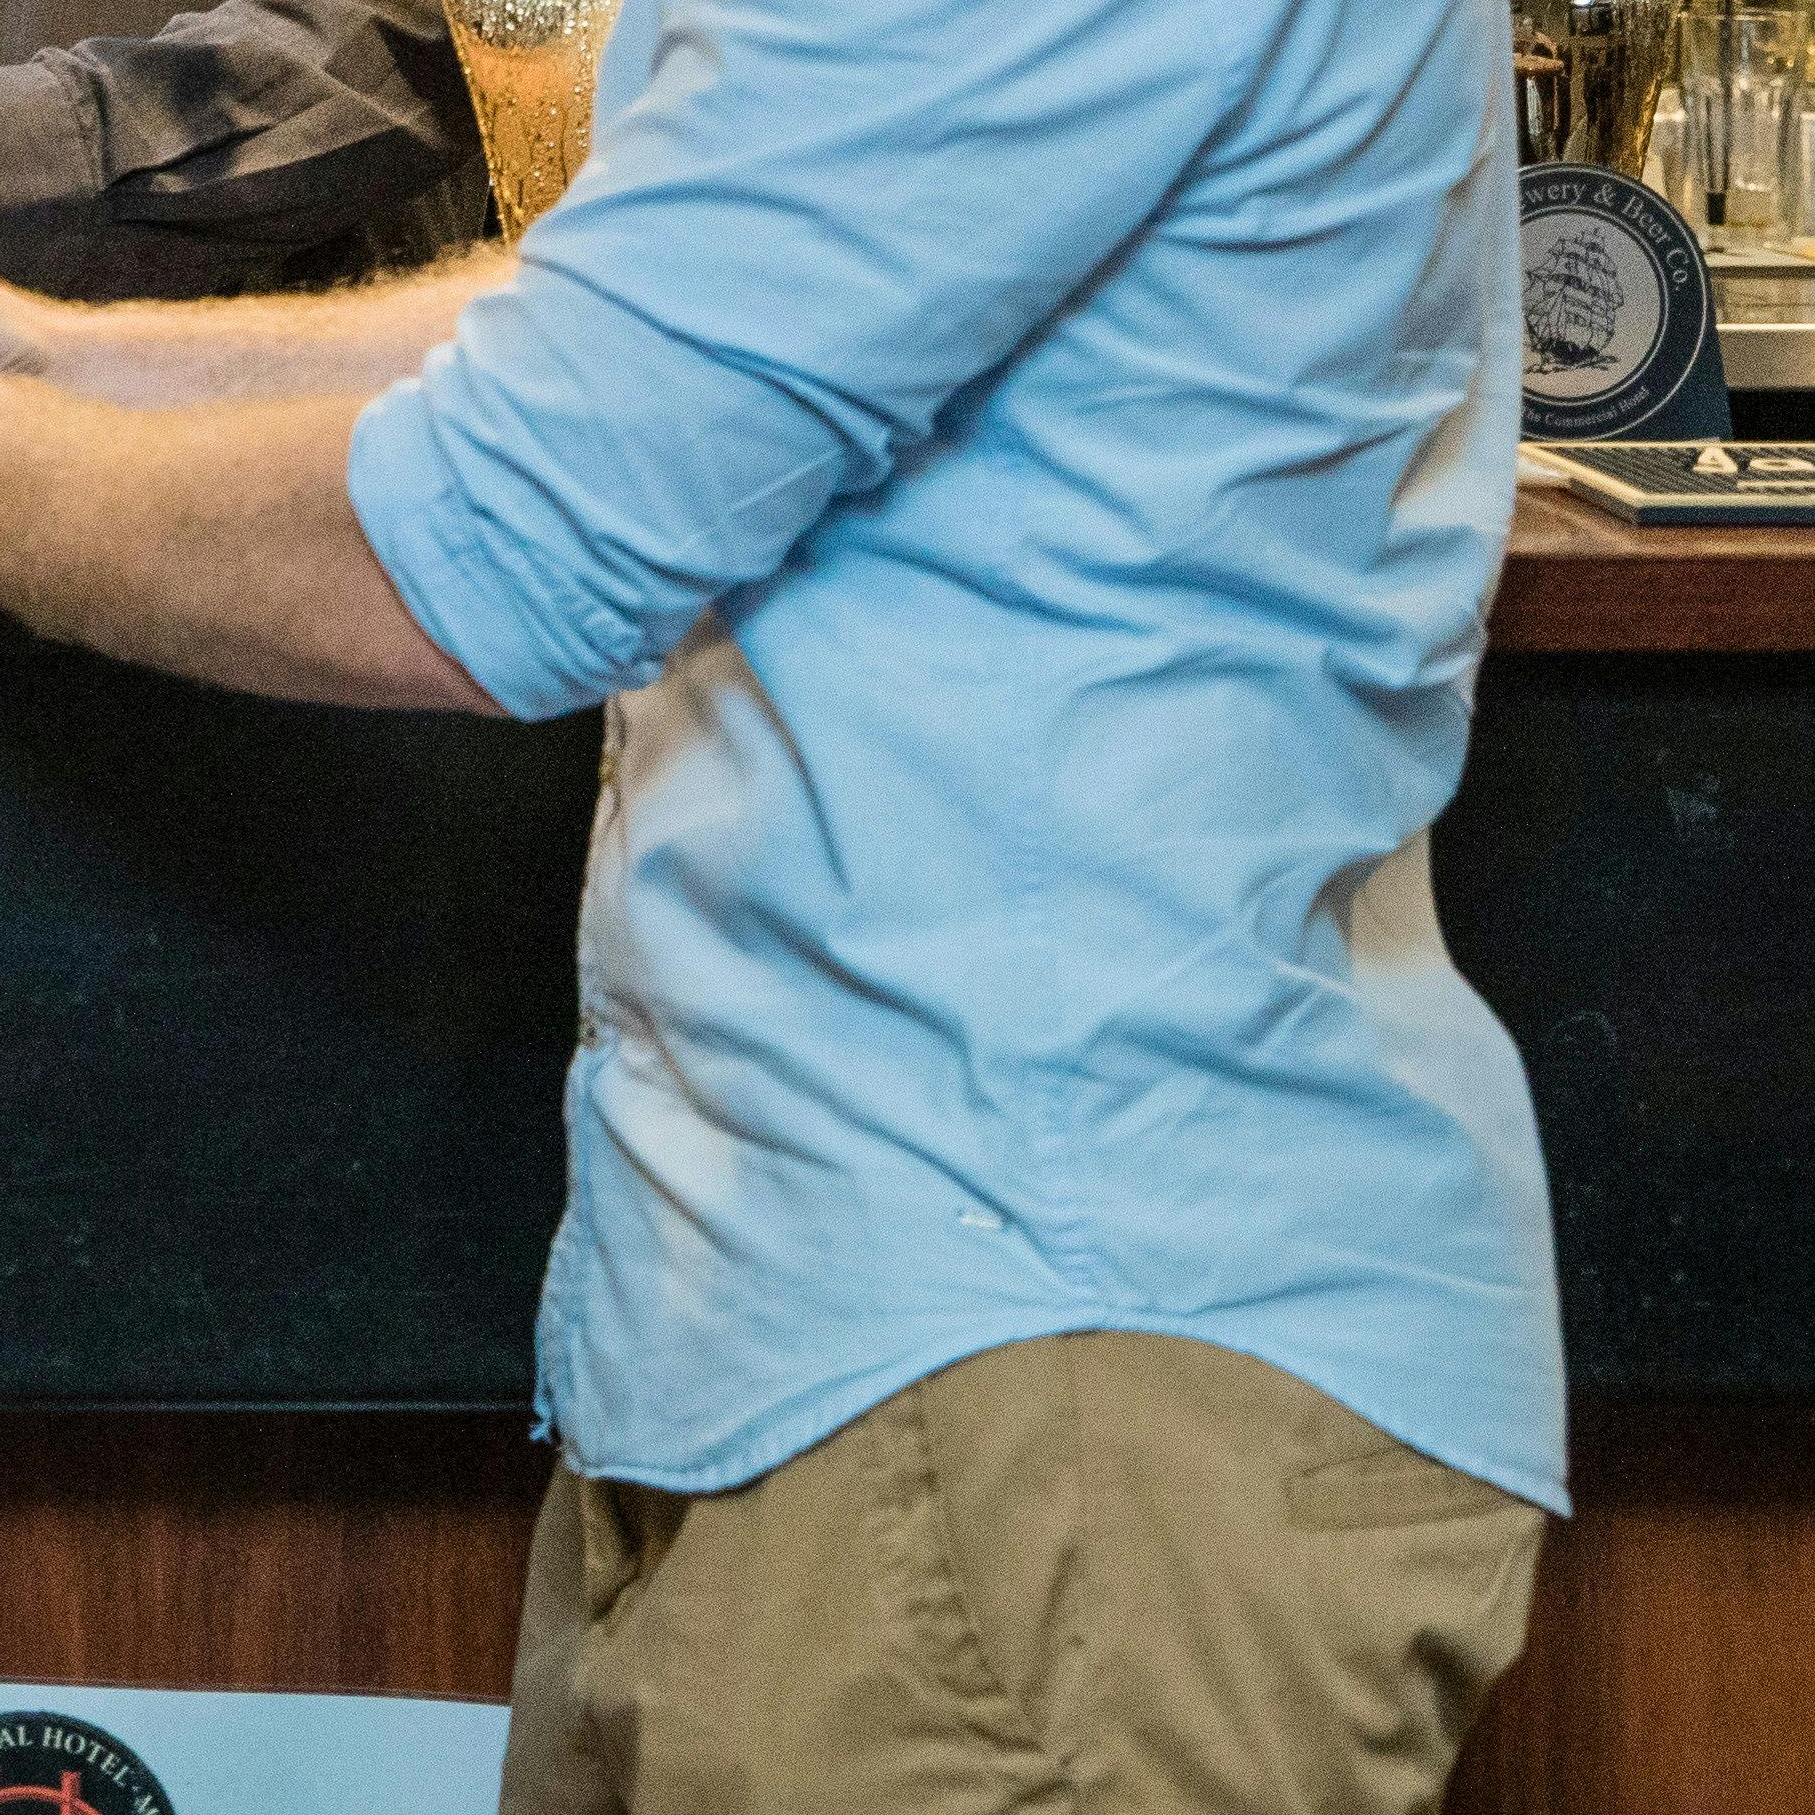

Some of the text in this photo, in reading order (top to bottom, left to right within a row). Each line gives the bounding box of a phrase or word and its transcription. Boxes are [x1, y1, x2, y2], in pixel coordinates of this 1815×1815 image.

[1594, 186, 1615, 206] &
[1623, 197, 1663, 243] Beer
[42, 1726, 132, 1787] HOTEL
